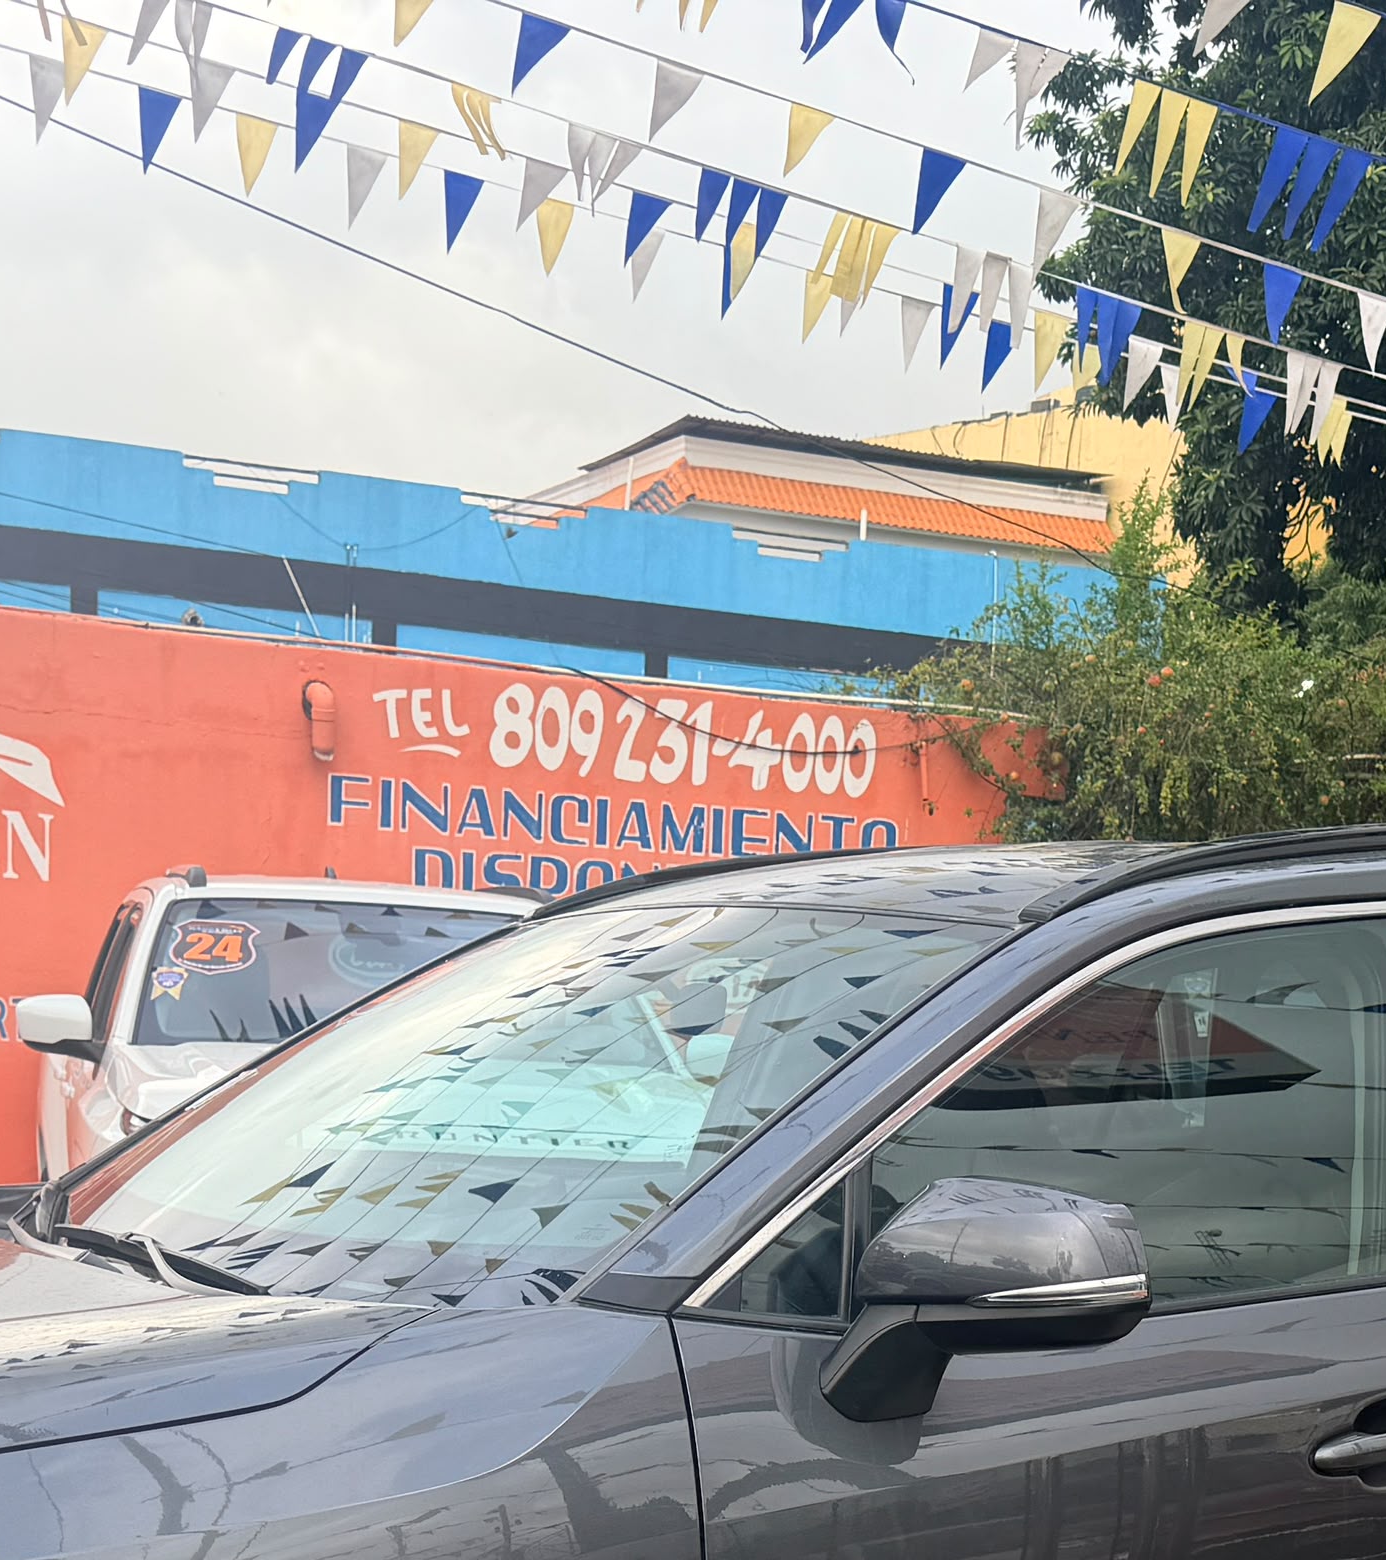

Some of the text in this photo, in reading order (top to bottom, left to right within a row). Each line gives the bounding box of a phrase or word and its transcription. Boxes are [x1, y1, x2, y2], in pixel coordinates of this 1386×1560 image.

[372, 682, 876, 799] TEL 809 231-4000
[327, 772, 898, 857] FINANCIAMIENTO
[183, 932, 243, 963] 24
